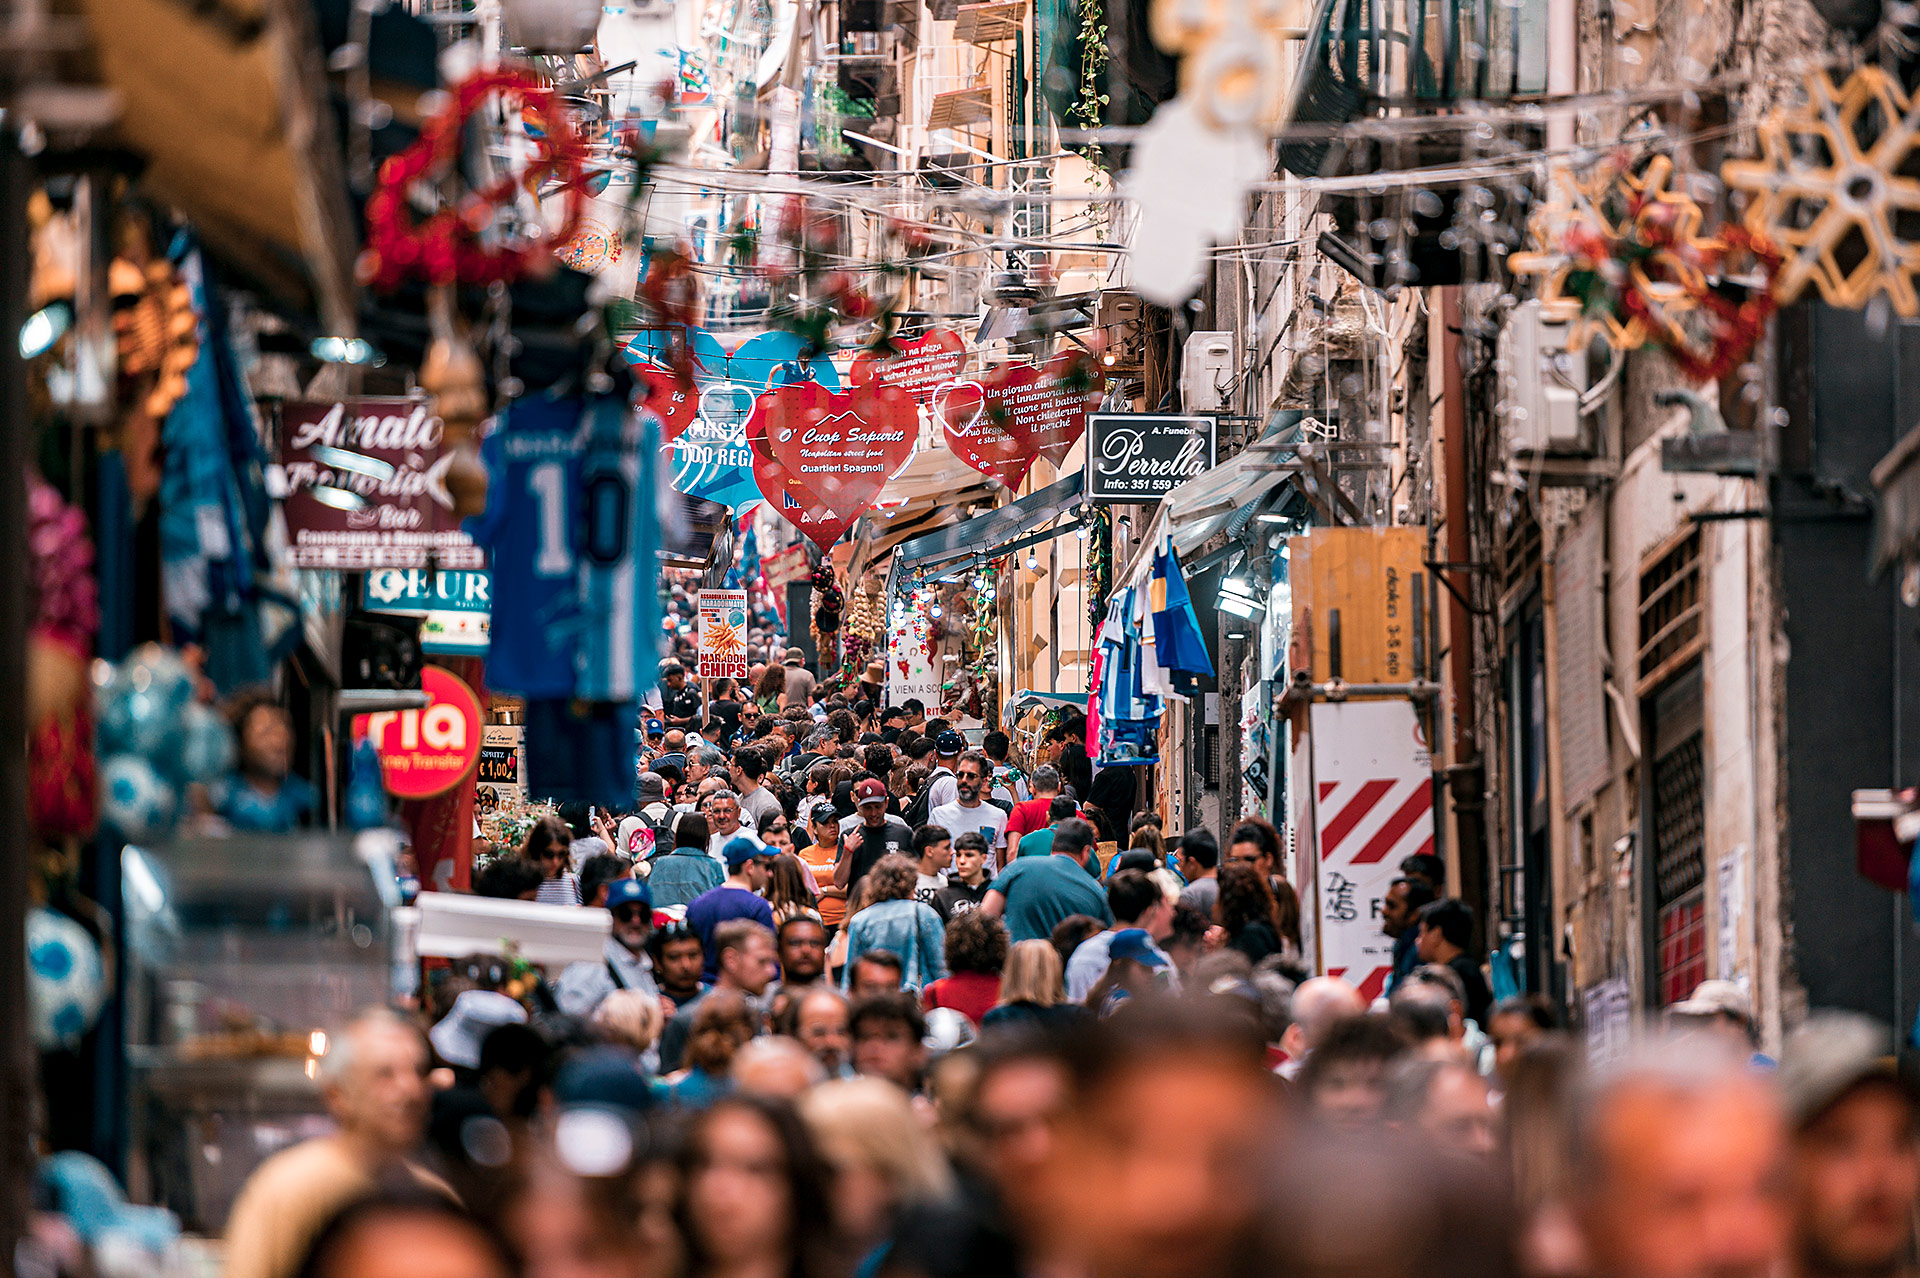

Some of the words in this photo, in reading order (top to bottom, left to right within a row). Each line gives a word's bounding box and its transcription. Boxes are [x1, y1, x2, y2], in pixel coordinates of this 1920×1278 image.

[908, 348, 919, 356] na
[921, 343, 942, 355] pizza
[909, 367, 922, 376] che
[987, 389, 1000, 398] Un
[1002, 384, 1032, 397] giorno
[1002, 396, 1015, 406] mi
[1016, 387, 1065, 403] innamorai
[1013, 404, 1039, 415] cuore
[1041, 399, 1053, 411] mi
[1055, 393, 1090, 409] batteva
[1015, 414, 1035, 426] Non
[1036, 404, 1082, 421] chiedermi
[1040, 417, 1071, 433] perché
[1151, 427, 1161, 435] A.
[1163, 427, 1196, 435] Funebri
[801, 427, 841, 445] Cuop
[845, 427, 905, 445] Sapurit
[984, 436, 996, 444] sta
[800, 448, 842, 459] Neapolitan
[843, 449, 866, 457] street
[865, 448, 884, 459] food
[1098, 428, 1206, 476] Perrella
[800, 463, 841, 473] Quartieri
[843, 463, 884, 473] Spagnoli
[1104, 479, 1129, 489] Info:
[1130, 479, 1149, 490] 351
[1152, 480, 1172, 489] 559
[700, 663, 746, 677] CHIPS
[895, 684, 916, 694] VIENI
[918, 684, 925, 693] A
[482, 751, 505, 759] SPRITZ
[480, 762, 485, 776] €
[488, 760, 507, 779] 1,00
